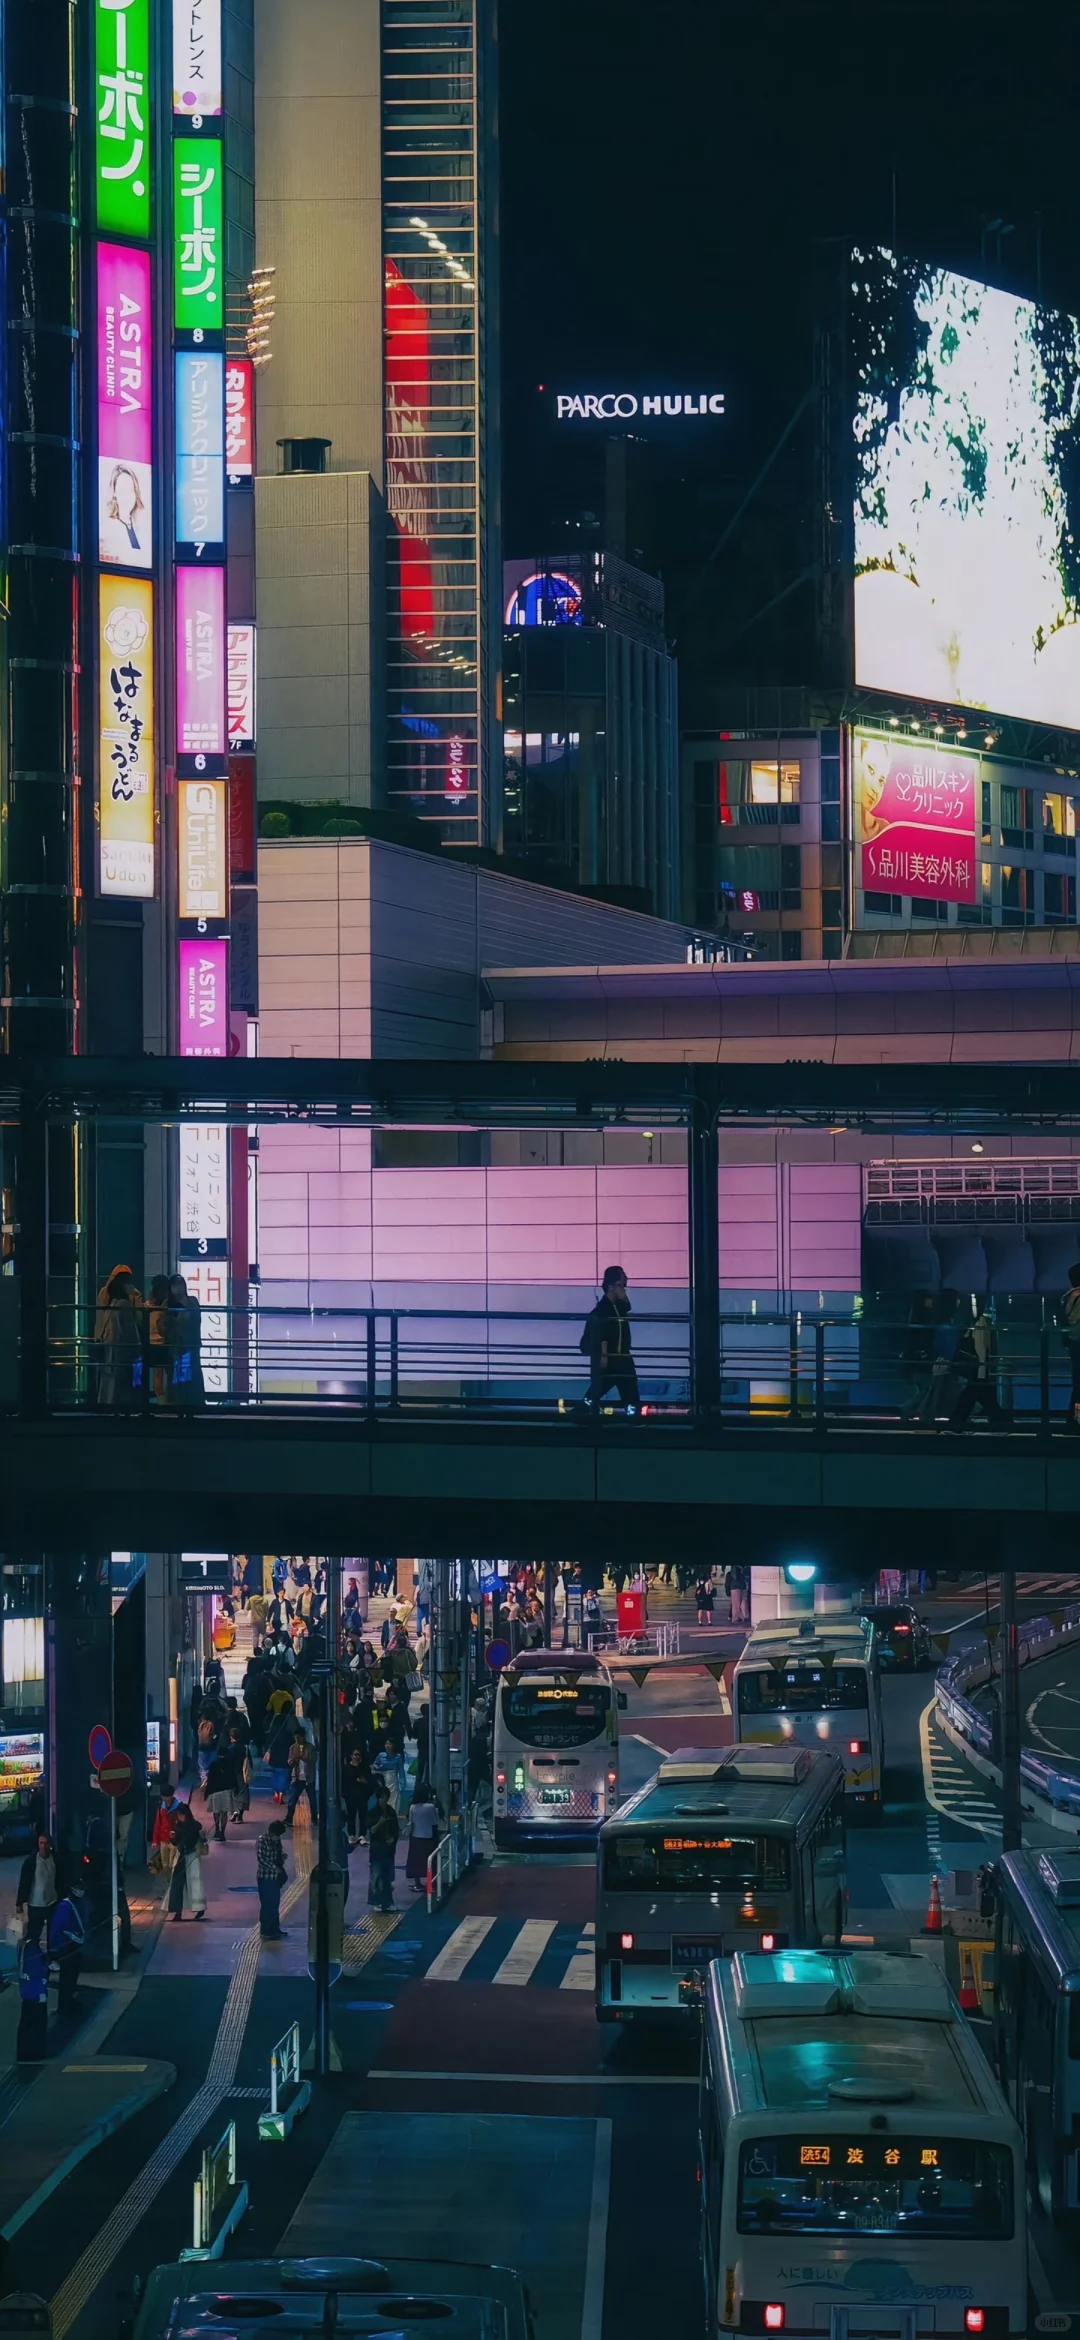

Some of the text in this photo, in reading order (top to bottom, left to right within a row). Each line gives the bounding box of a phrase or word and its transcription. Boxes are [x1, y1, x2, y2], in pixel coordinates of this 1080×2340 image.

[192, 114, 203, 129] 9
[105, 306, 114, 354] BEAUTY
[192, 328, 204, 343] 8
[119, 293, 141, 414] ASTRA
[226, 368, 246, 458] カラオケ
[557, 394, 725, 419] PARCO HULIC
[190, 361, 209, 533] アリシアクリニック
[194, 543, 206, 557] 7
[196, 610, 213, 681] ASTRA
[229, 740, 242, 750] 7F
[194, 755, 206, 770] 6
[912, 764, 970, 794] 品川スキン
[913, 791, 964, 819] クリニック
[187, 814, 207, 891] UniLife
[106, 866, 146, 883] Udon
[879, 848, 970, 889] 品川美容外科
[197, 917, 207, 933] 5
[199, 958, 216, 1028] ASTRA
[197, 1238, 208, 1254] 3
[801, 2147, 939, 2165] 渋54 渋谷駅
